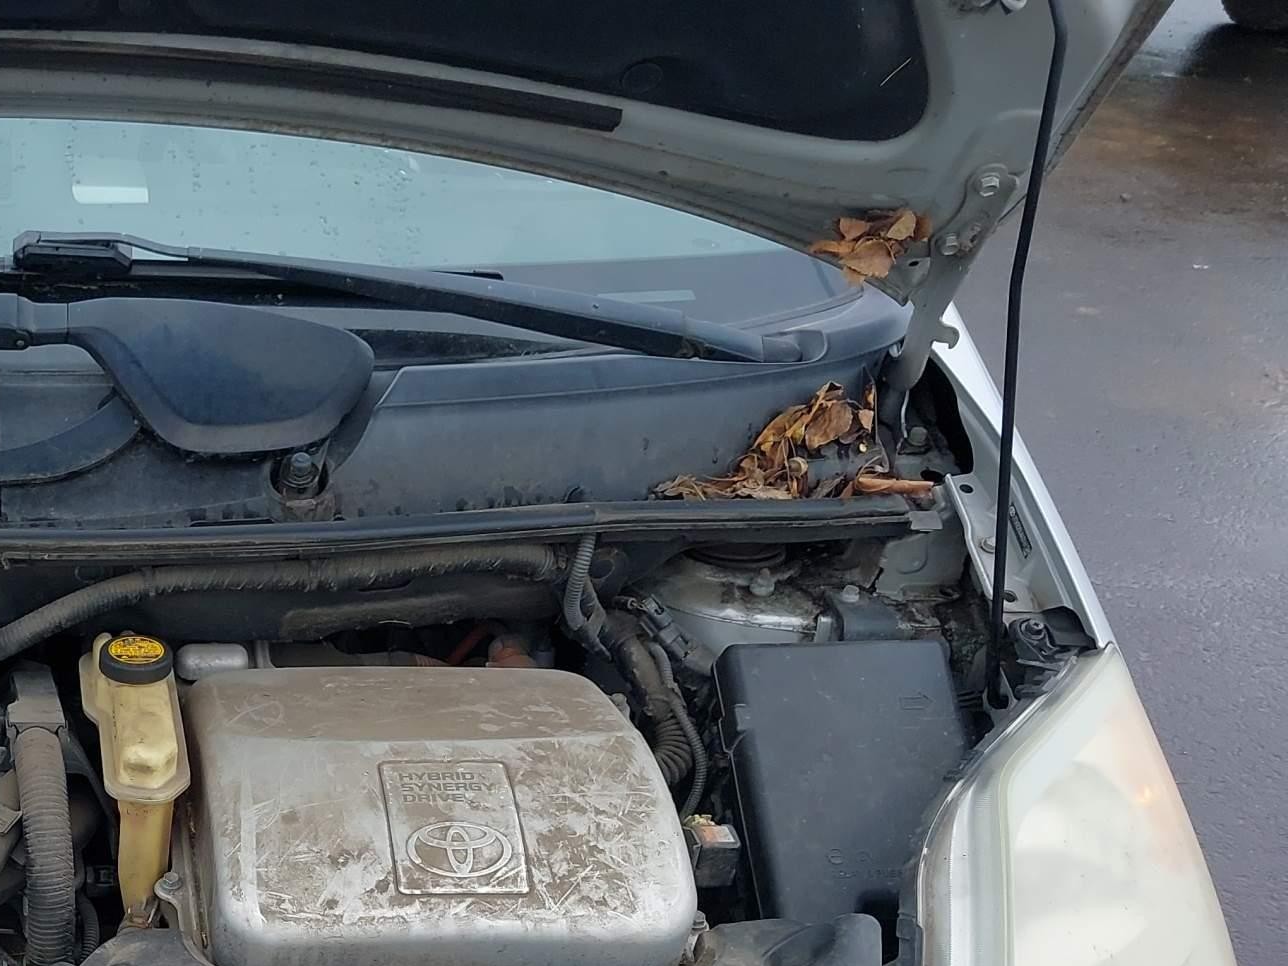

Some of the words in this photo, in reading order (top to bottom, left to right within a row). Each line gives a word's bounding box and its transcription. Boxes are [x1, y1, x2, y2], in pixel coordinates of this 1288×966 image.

[398, 771, 475, 781] HYBRID
[400, 782, 496, 792] SYNERGY
[402, 793, 465, 803] DRIVE
